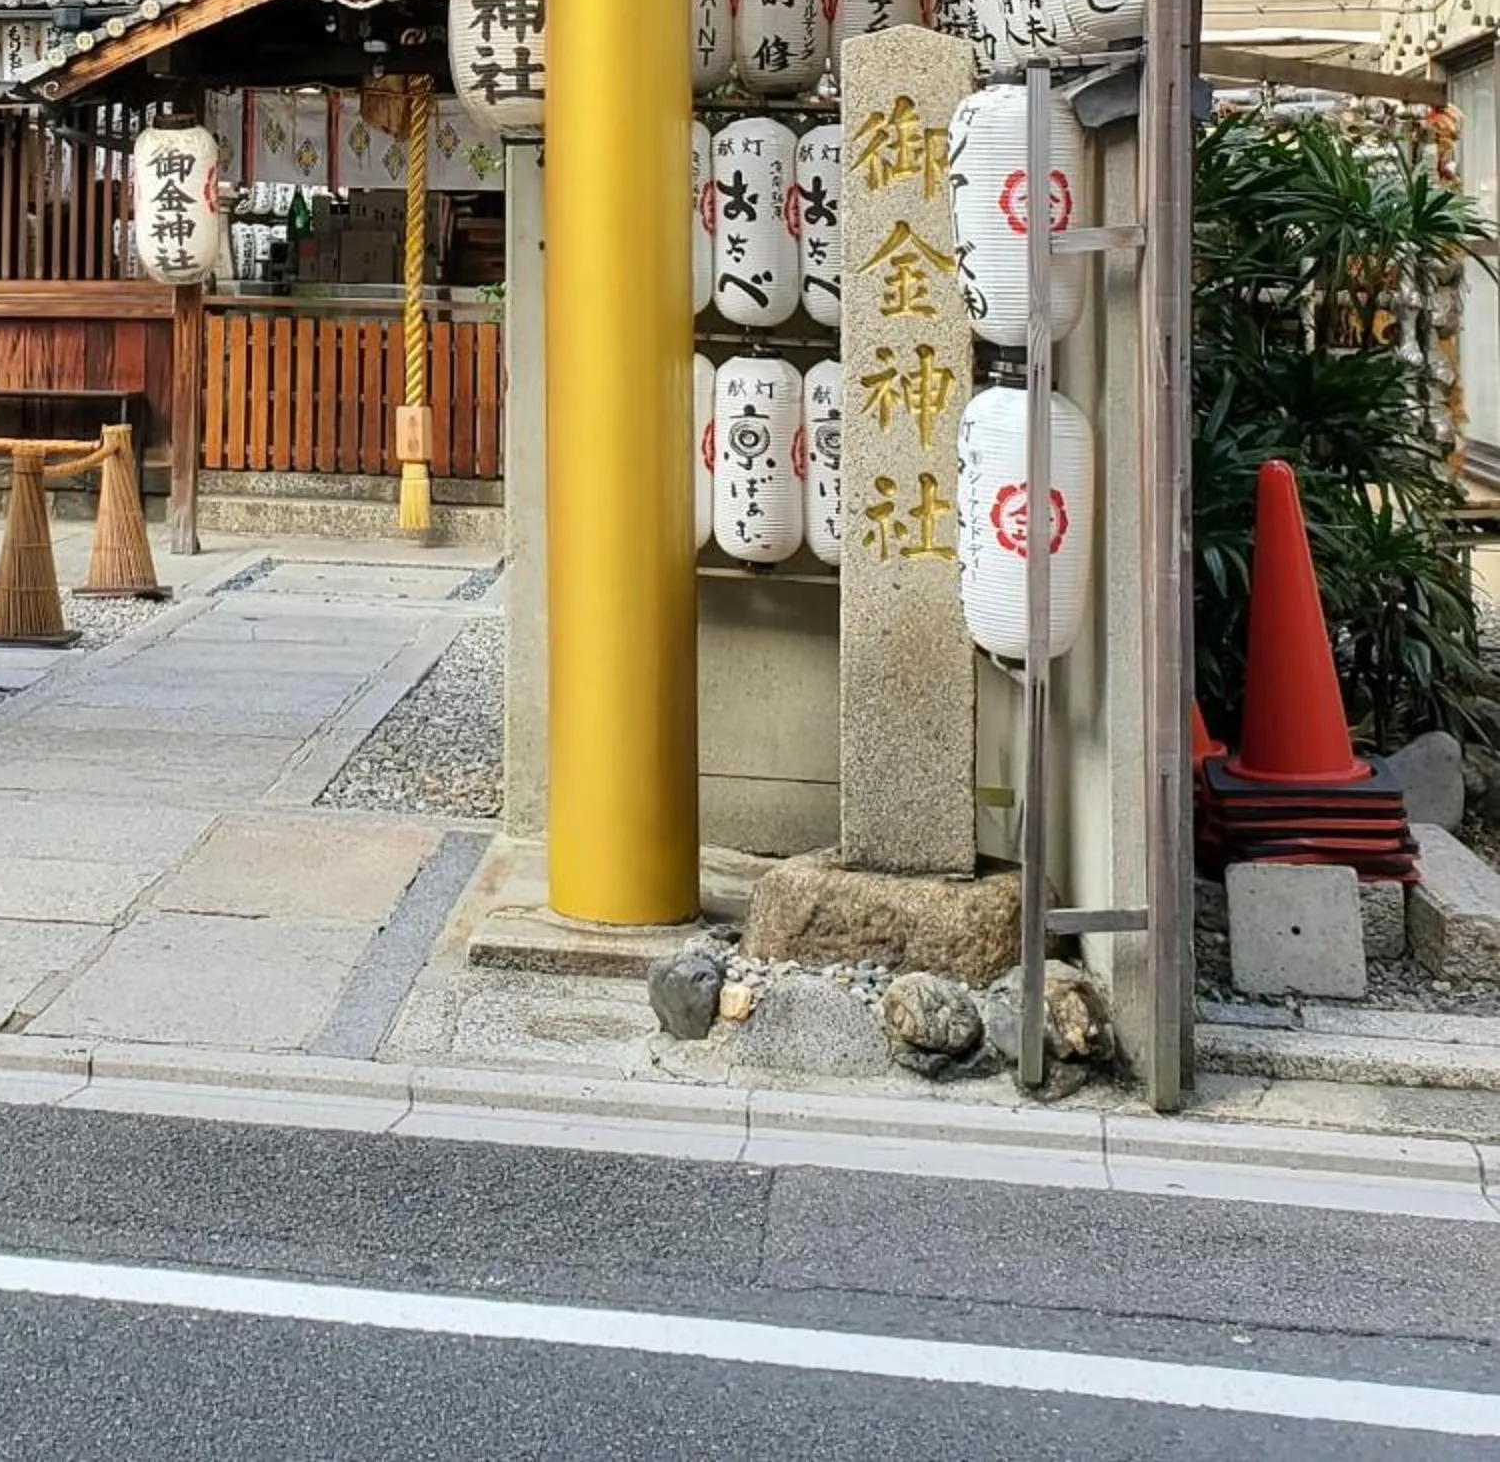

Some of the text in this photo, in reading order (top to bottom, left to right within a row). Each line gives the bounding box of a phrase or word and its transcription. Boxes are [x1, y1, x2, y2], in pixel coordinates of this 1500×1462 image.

[146, 147, 198, 272] 御金神社
[850, 94, 958, 563] 御金神社
